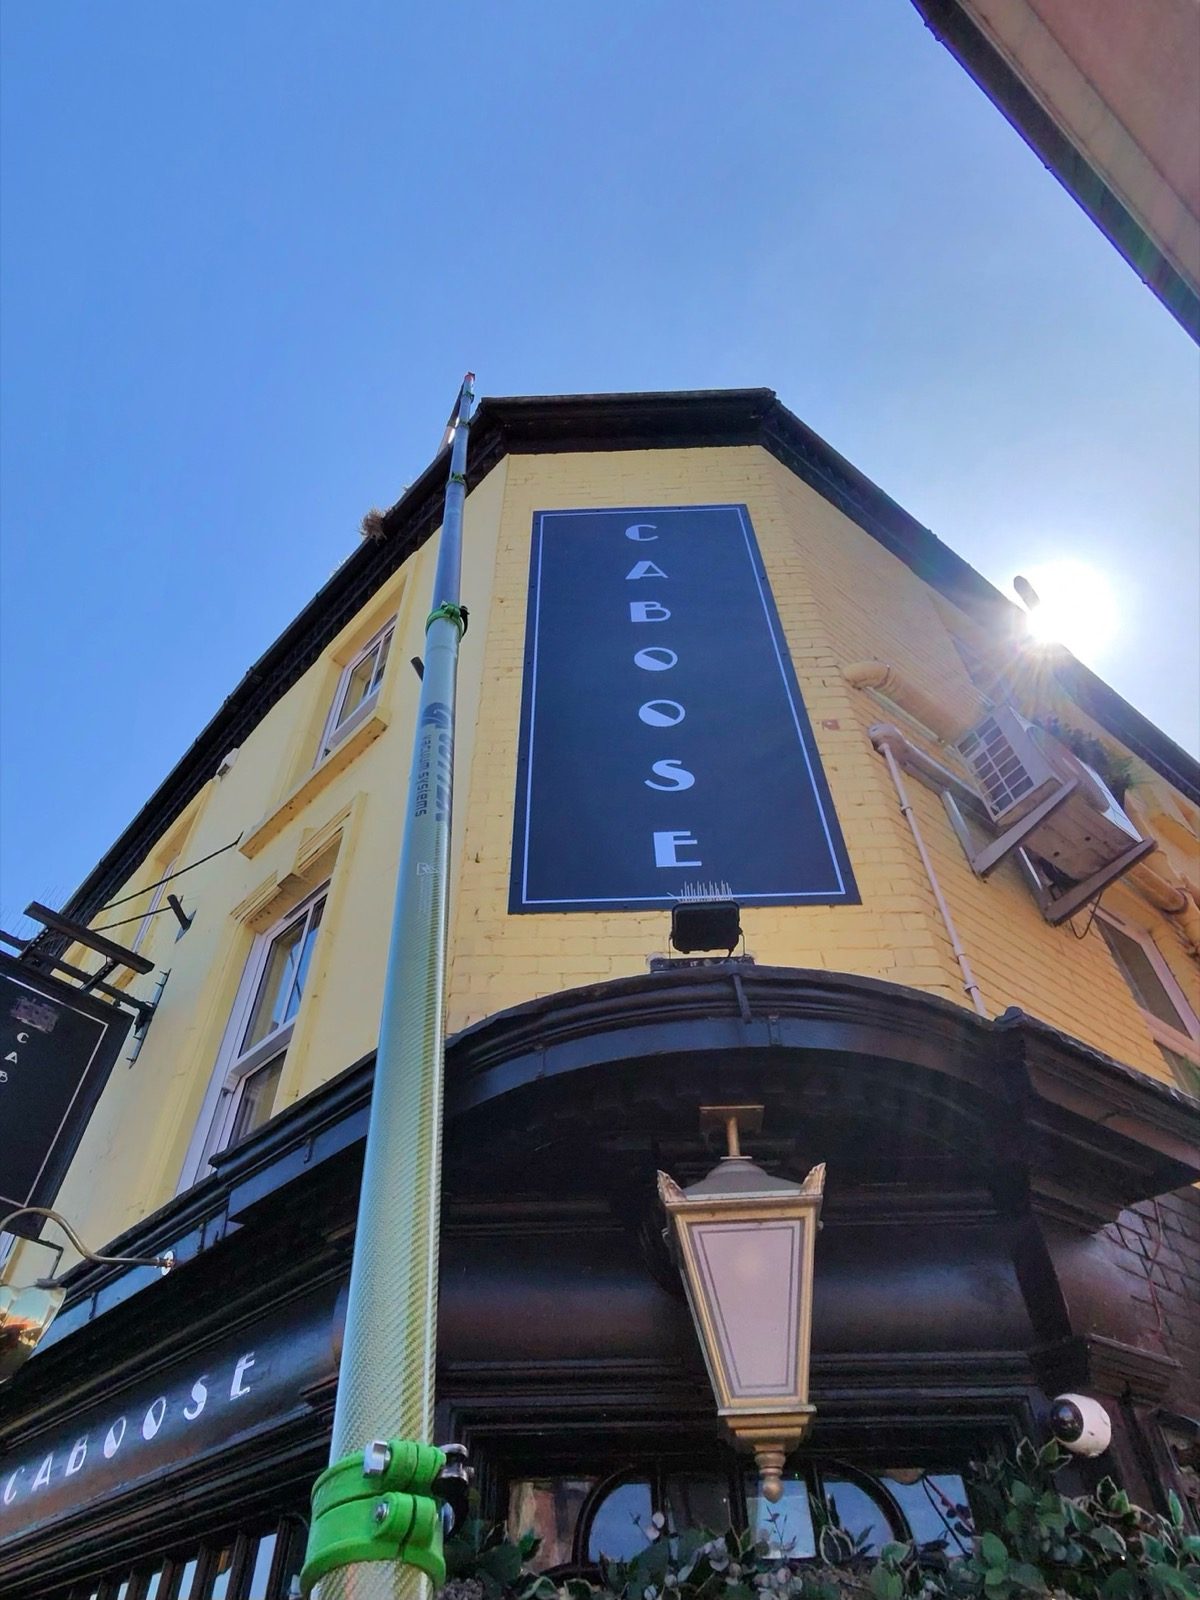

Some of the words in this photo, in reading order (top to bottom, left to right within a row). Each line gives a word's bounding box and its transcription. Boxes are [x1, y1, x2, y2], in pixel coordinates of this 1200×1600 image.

[625, 524, 702, 868] CABOOSE
[415, 771, 430, 818] systems
[3, 1351, 256, 1506] CABOOSE
